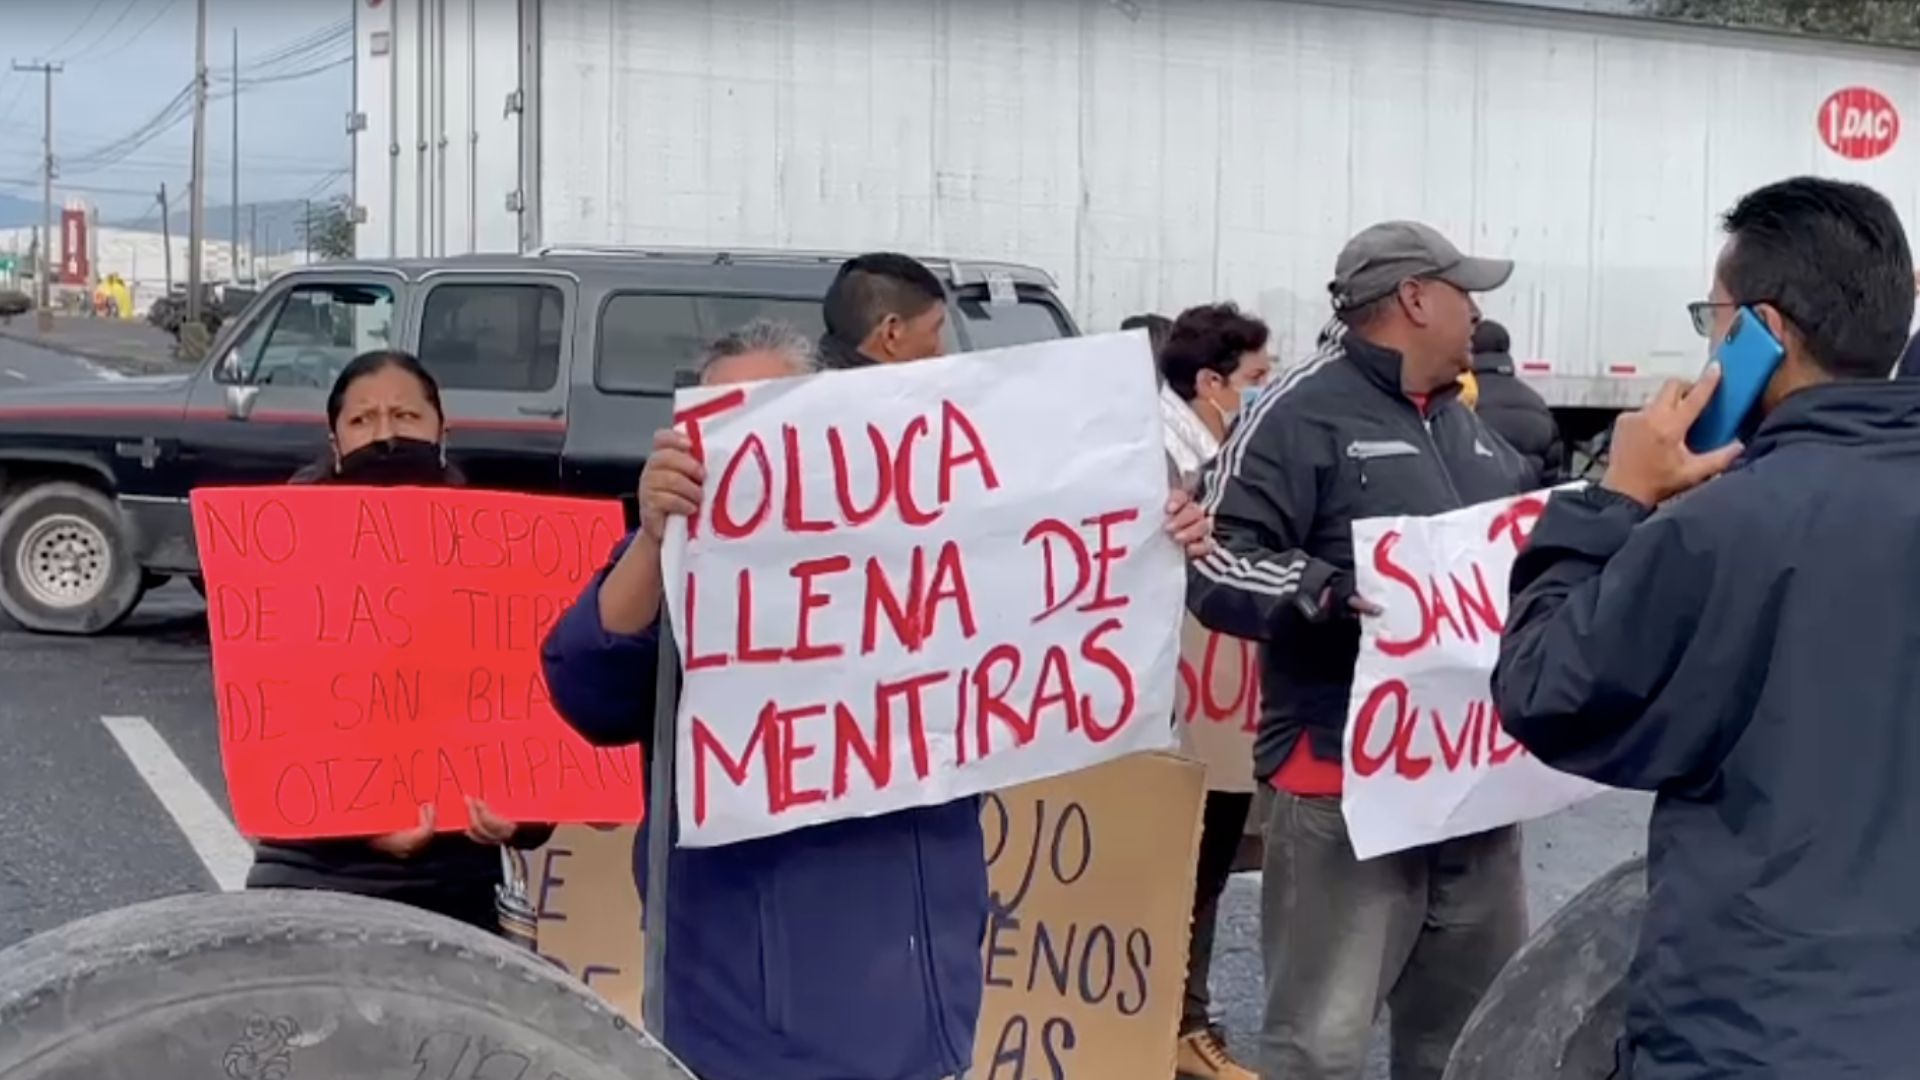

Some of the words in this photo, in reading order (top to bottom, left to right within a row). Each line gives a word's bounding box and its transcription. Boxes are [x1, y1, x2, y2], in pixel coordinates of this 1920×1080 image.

[673, 390, 1000, 540] TOLUCA
[203, 498, 297, 563] NO
[352, 499, 408, 564] AL
[428, 502, 617, 583] DESPOJO
[685, 541, 978, 671] LLENA
[1023, 508, 1139, 623] DE
[216, 583, 280, 642] DE
[315, 584, 413, 648] LAS
[452, 588, 575, 651] TIER
[225, 679, 290, 743] DE
[330, 669, 421, 730] SAN
[465, 667, 551, 724] BLA
[692, 619, 1136, 829] MENTIRAS
[984, 916, 1152, 1016] ENOS
